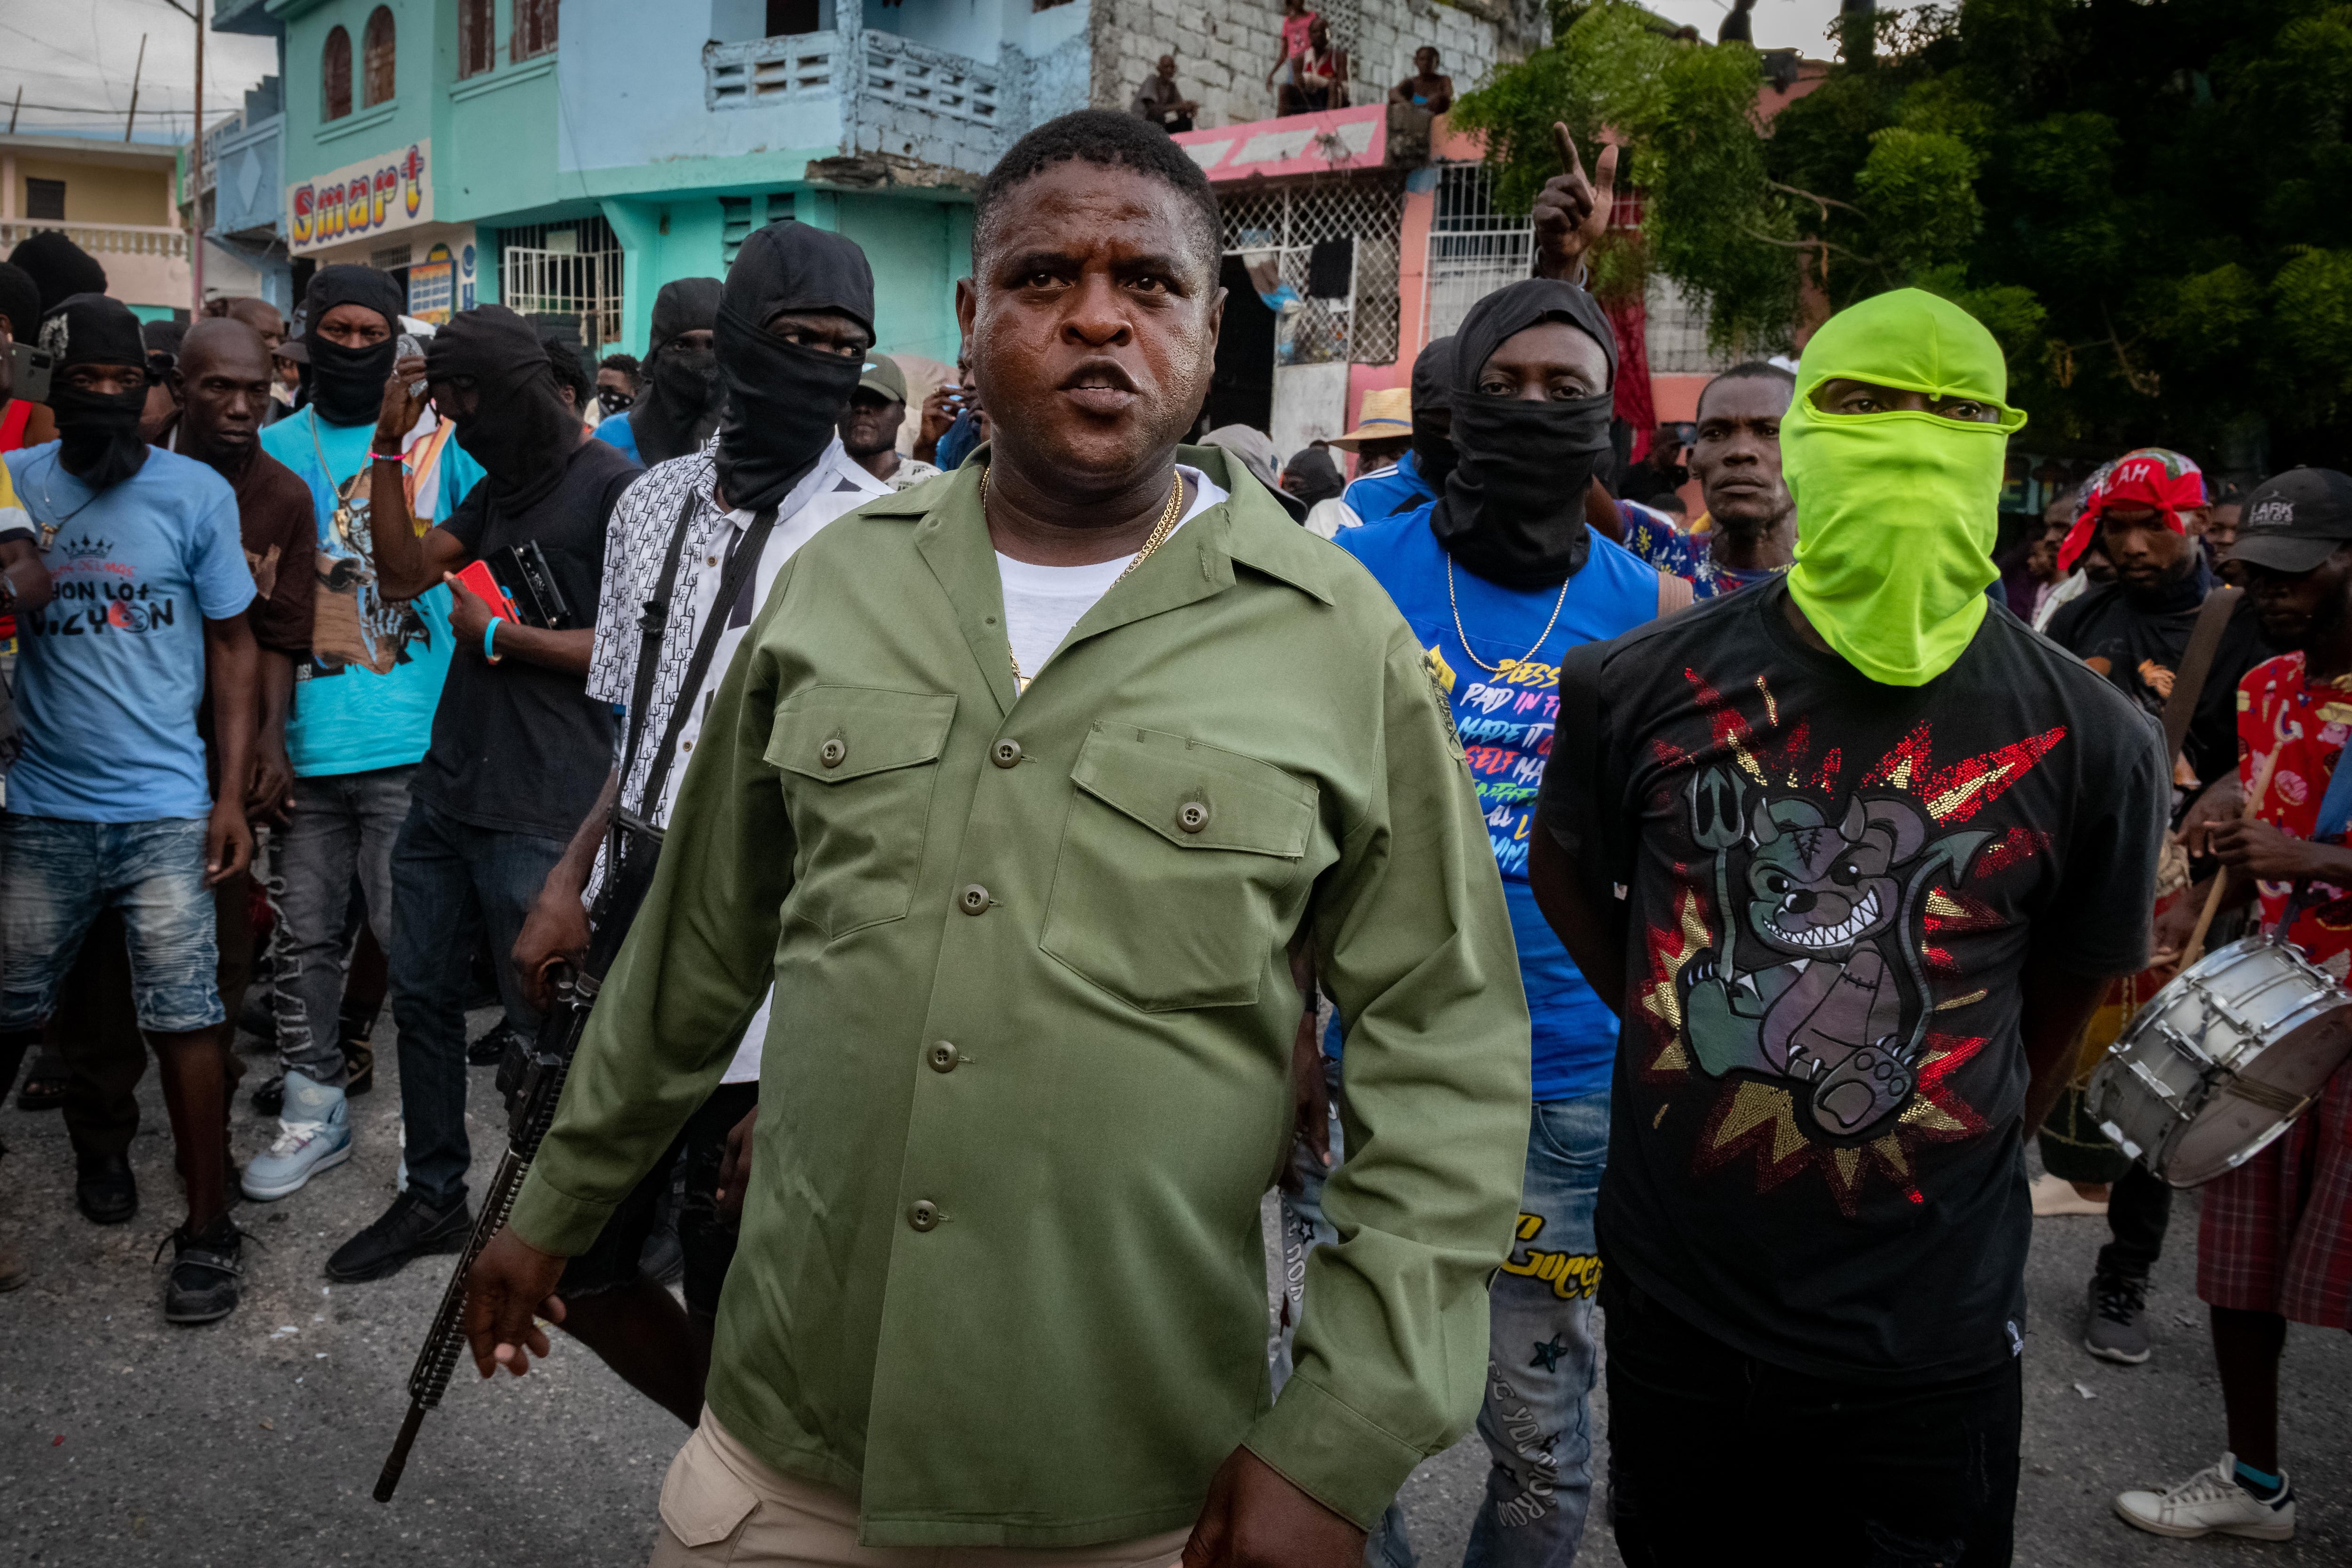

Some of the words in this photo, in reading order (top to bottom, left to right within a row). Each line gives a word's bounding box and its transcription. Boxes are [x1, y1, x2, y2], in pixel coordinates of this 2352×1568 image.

[294, 144, 424, 247] Smart
[1459, 683, 1515, 715] PAID
[1513, 691, 1544, 715] IN
[1458, 716, 1529, 744] MADE
[1521, 723, 1555, 748] IT
